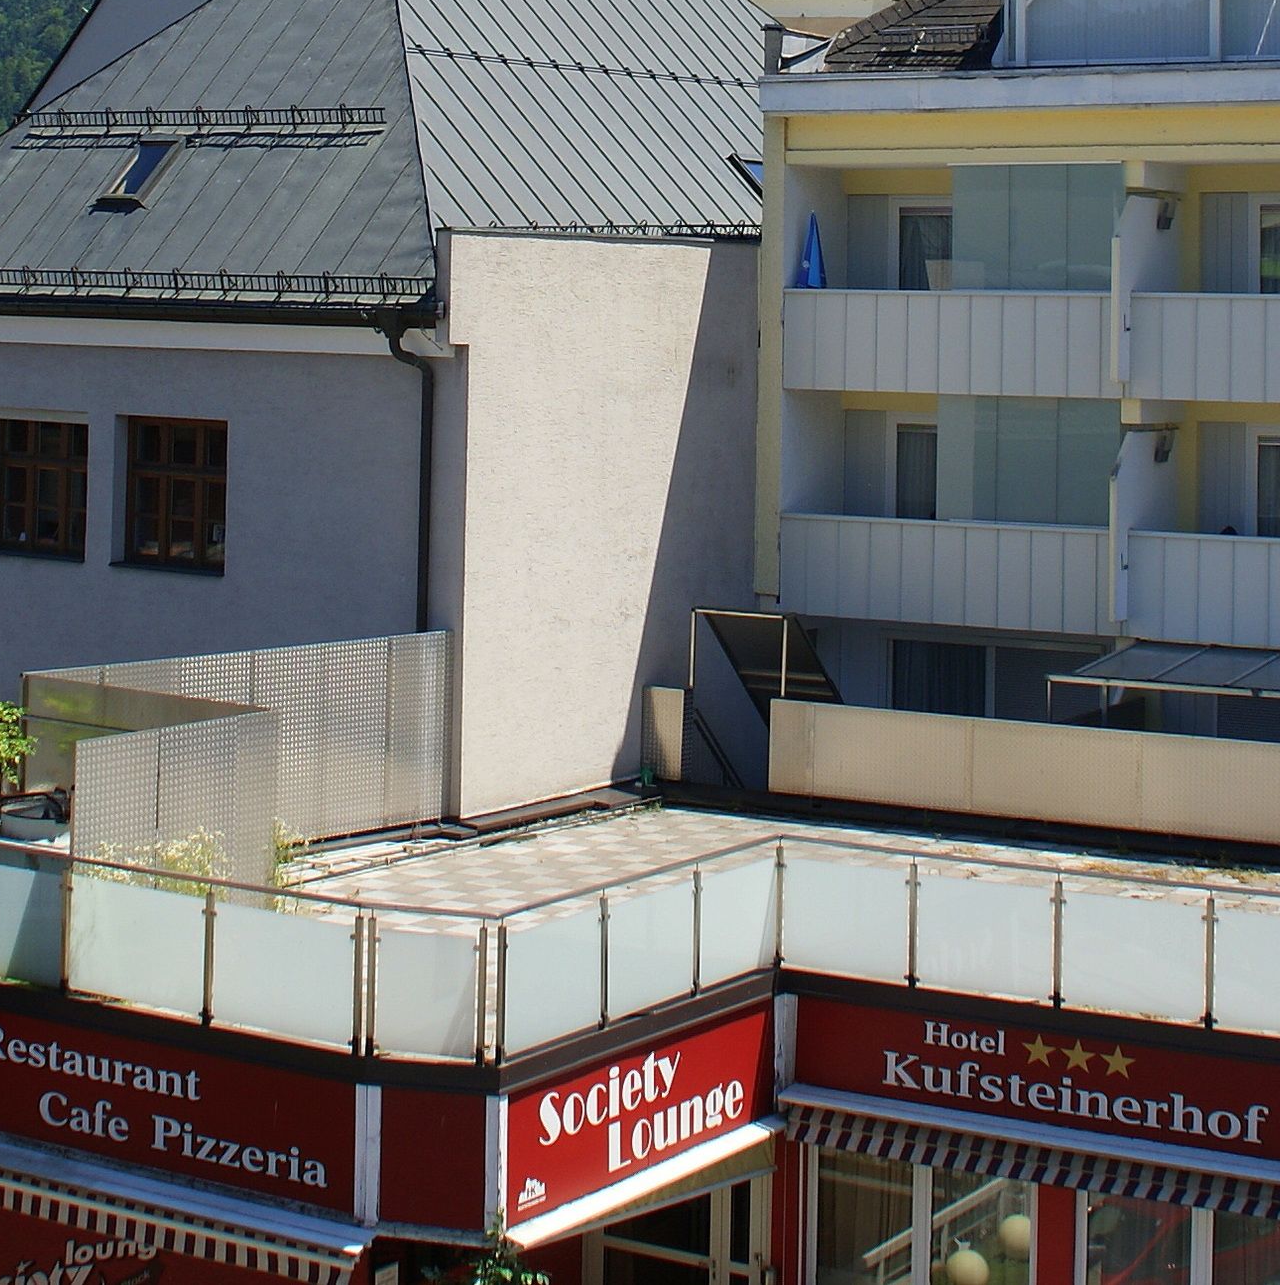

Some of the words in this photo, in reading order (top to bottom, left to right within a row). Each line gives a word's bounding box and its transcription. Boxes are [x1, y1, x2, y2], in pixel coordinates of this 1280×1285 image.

[923, 1020, 1006, 1056] Hotel
[38, 1091, 130, 1143] Cafe
[150, 1114, 328, 1189] Pizzeria
[538, 1050, 682, 1147] Society
[607, 1079, 745, 1174] Lounge
[881, 1050, 1270, 1145] Kufsteinerhof
[65, 1239, 158, 1265] loung
